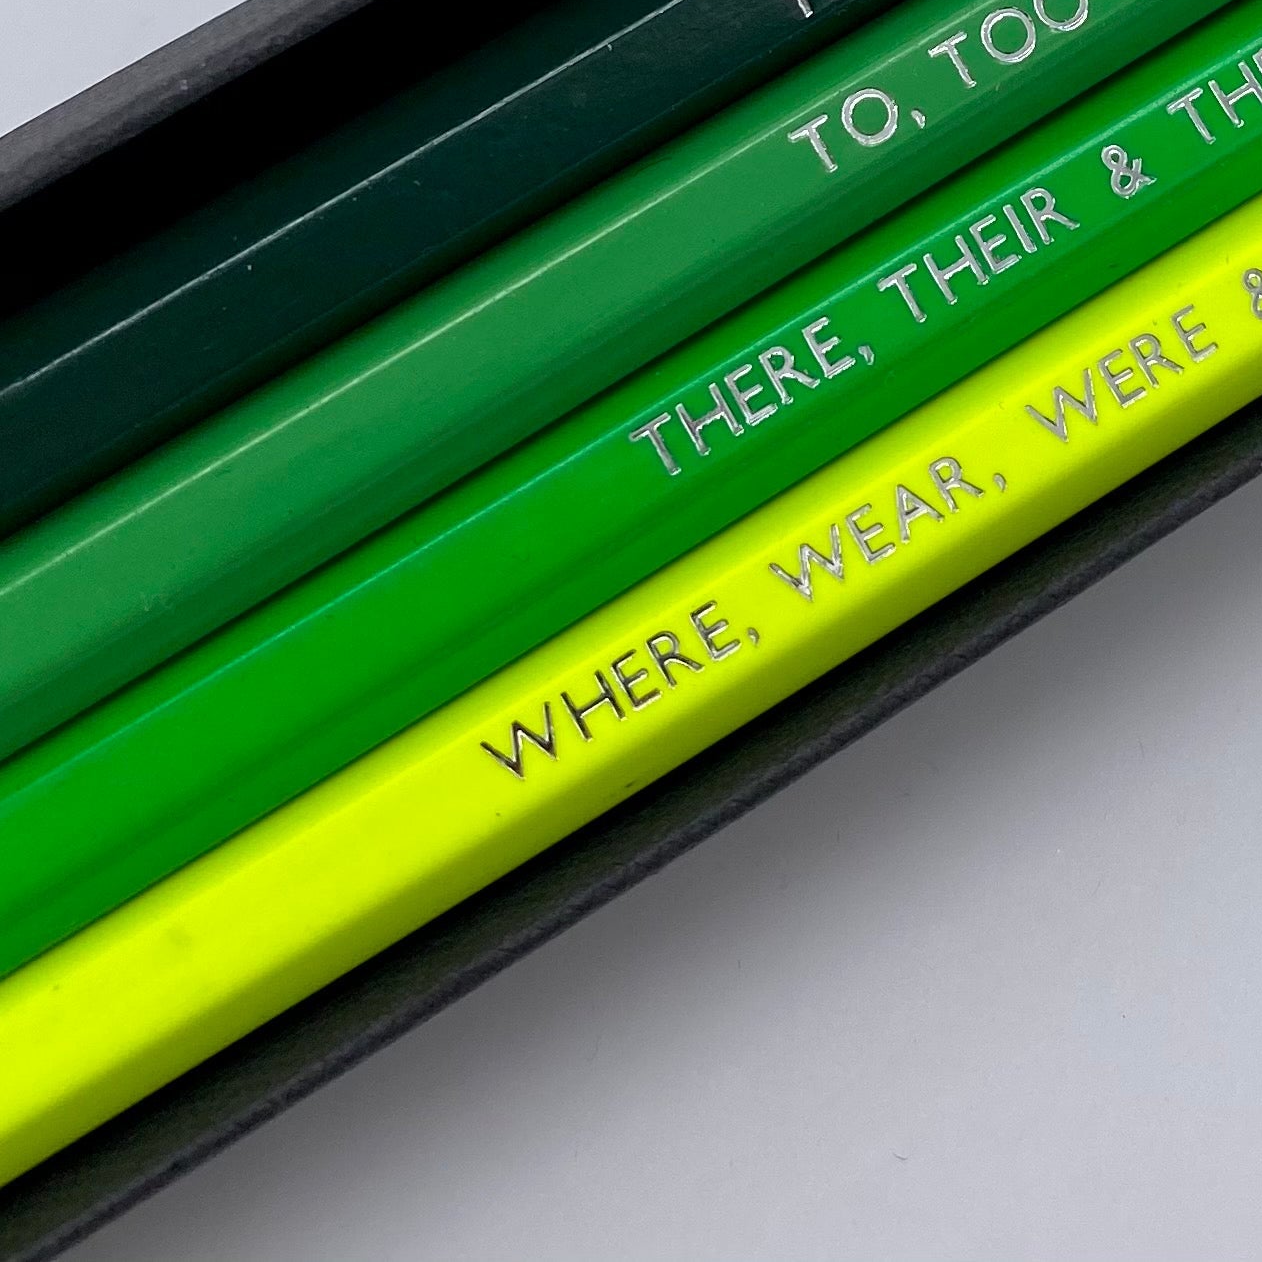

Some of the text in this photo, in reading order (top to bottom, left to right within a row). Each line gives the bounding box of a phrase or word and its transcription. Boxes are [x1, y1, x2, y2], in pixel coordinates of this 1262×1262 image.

[787, 87, 926, 173] TO,
[629, 315, 876, 476] THERE,
[877, 186, 1081, 323] THEIR
[1100, 143, 1158, 200] &
[479, 599, 760, 781] WHERE,
[768, 455, 1008, 603] WEAR,
[1024, 303, 1219, 443] WERE
